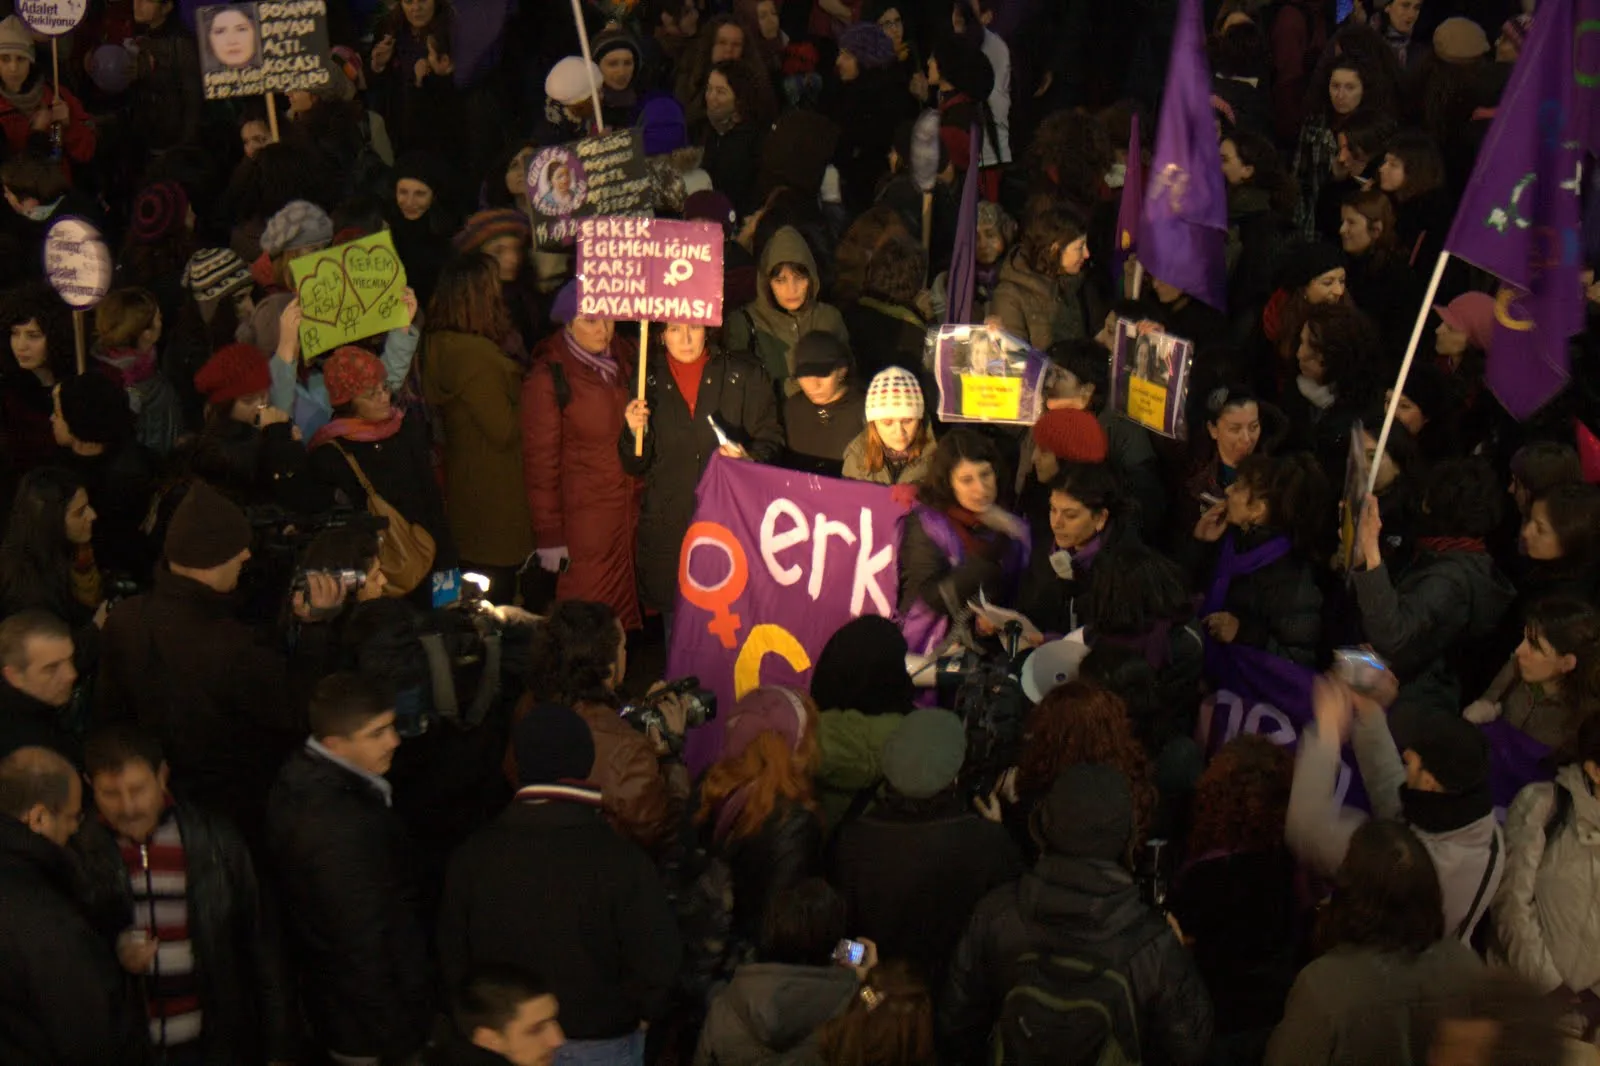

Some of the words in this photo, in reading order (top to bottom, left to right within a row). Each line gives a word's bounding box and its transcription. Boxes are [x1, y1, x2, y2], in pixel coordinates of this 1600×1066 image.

[21, 2, 58, 15] Adalet
[582, 219, 651, 239] ERKEK
[582, 238, 712, 262] EGEMENLİĞİNE
[349, 256, 394, 272] KEREM
[583, 259, 642, 278] KARŞI
[582, 276, 646, 295] KADIN
[582, 295, 713, 319] DAYANIŞMASI
[759, 497, 893, 618] erk
